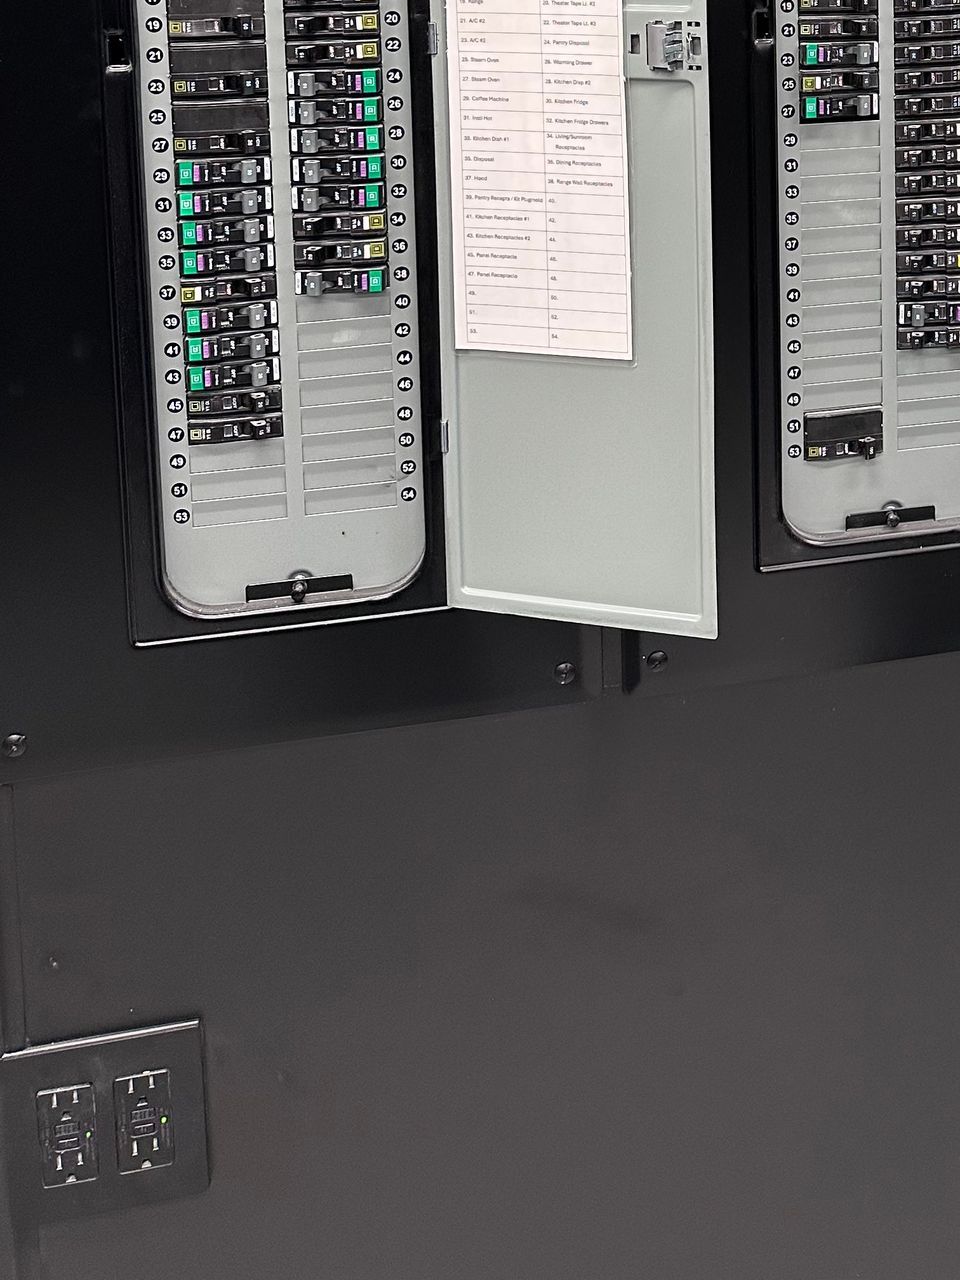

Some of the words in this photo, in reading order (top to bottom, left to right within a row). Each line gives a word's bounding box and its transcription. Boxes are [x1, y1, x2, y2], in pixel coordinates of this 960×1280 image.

[386, 14, 398, 23] 20
[783, 26, 793, 35] 21
[149, 50, 161, 61] 21
[388, 71, 401, 81] 24
[150, 82, 163, 92] 23
[155, 171, 168, 181] 29
[391, 214, 404, 224] 34
[161, 258, 173, 268] 35
[788, 291, 799, 300] 41
[396, 325, 409, 335] 42
[788, 368, 799, 377] 47
[399, 380, 411, 389] 46
[169, 401, 182, 411] 45
[789, 447, 800, 456] 53
[171, 457, 184, 467] 49
[402, 489, 415, 500] 54
[175, 512, 188, 522] 53
